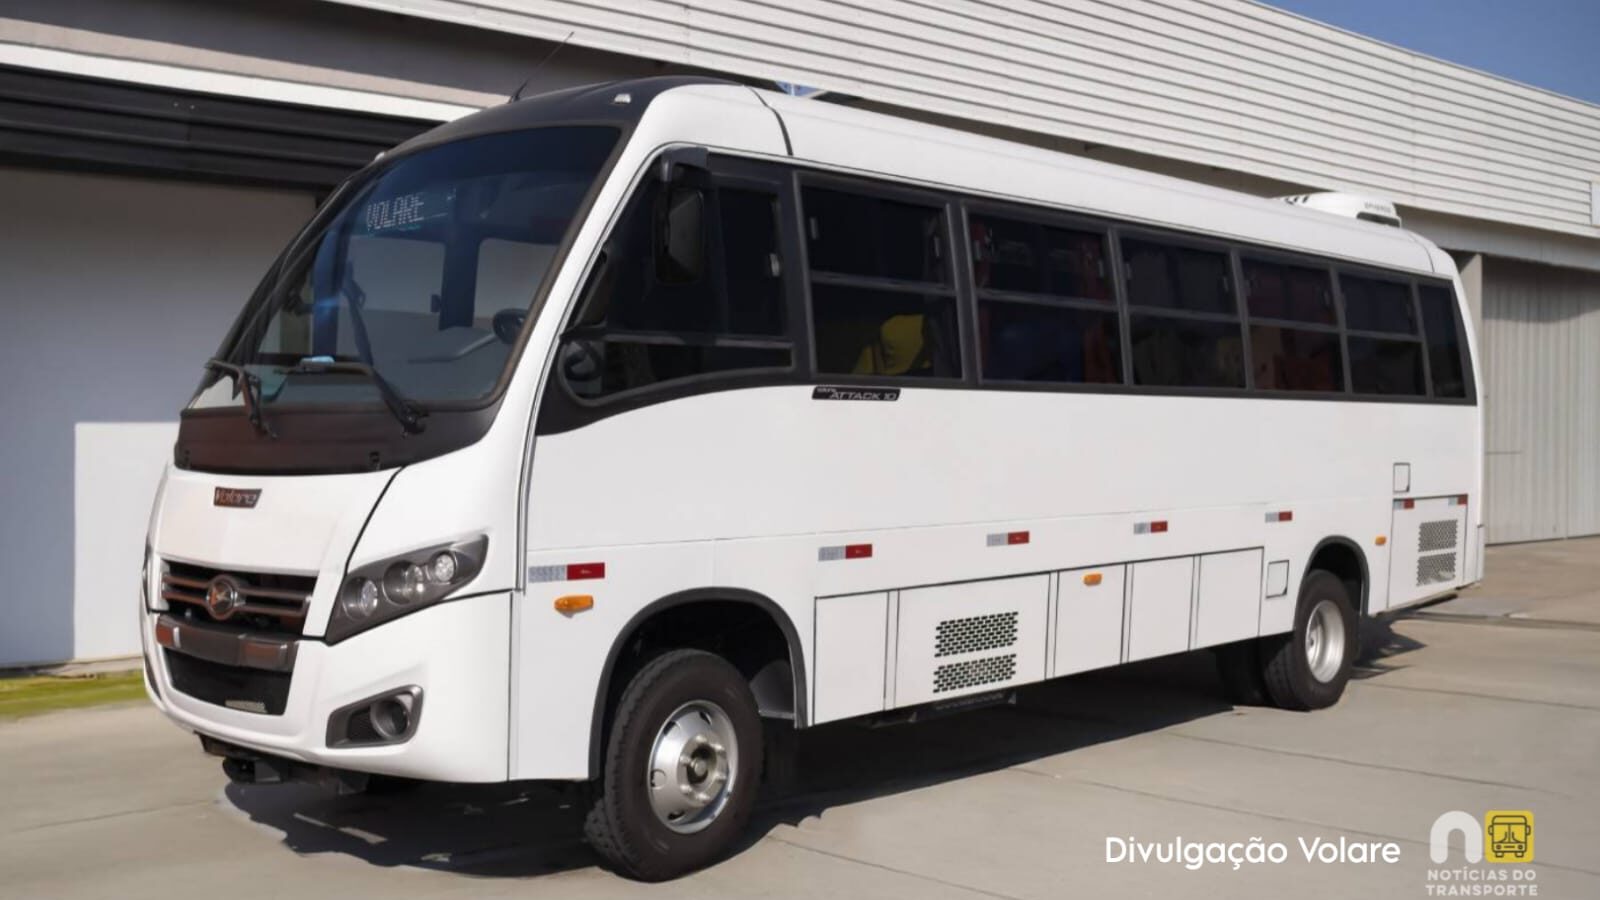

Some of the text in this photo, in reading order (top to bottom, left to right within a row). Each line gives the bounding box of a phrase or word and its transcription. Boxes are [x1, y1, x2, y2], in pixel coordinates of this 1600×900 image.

[367, 194, 424, 230] VOLARE
[829, 390, 881, 401] ATTACK
[883, 391, 898, 402] 10
